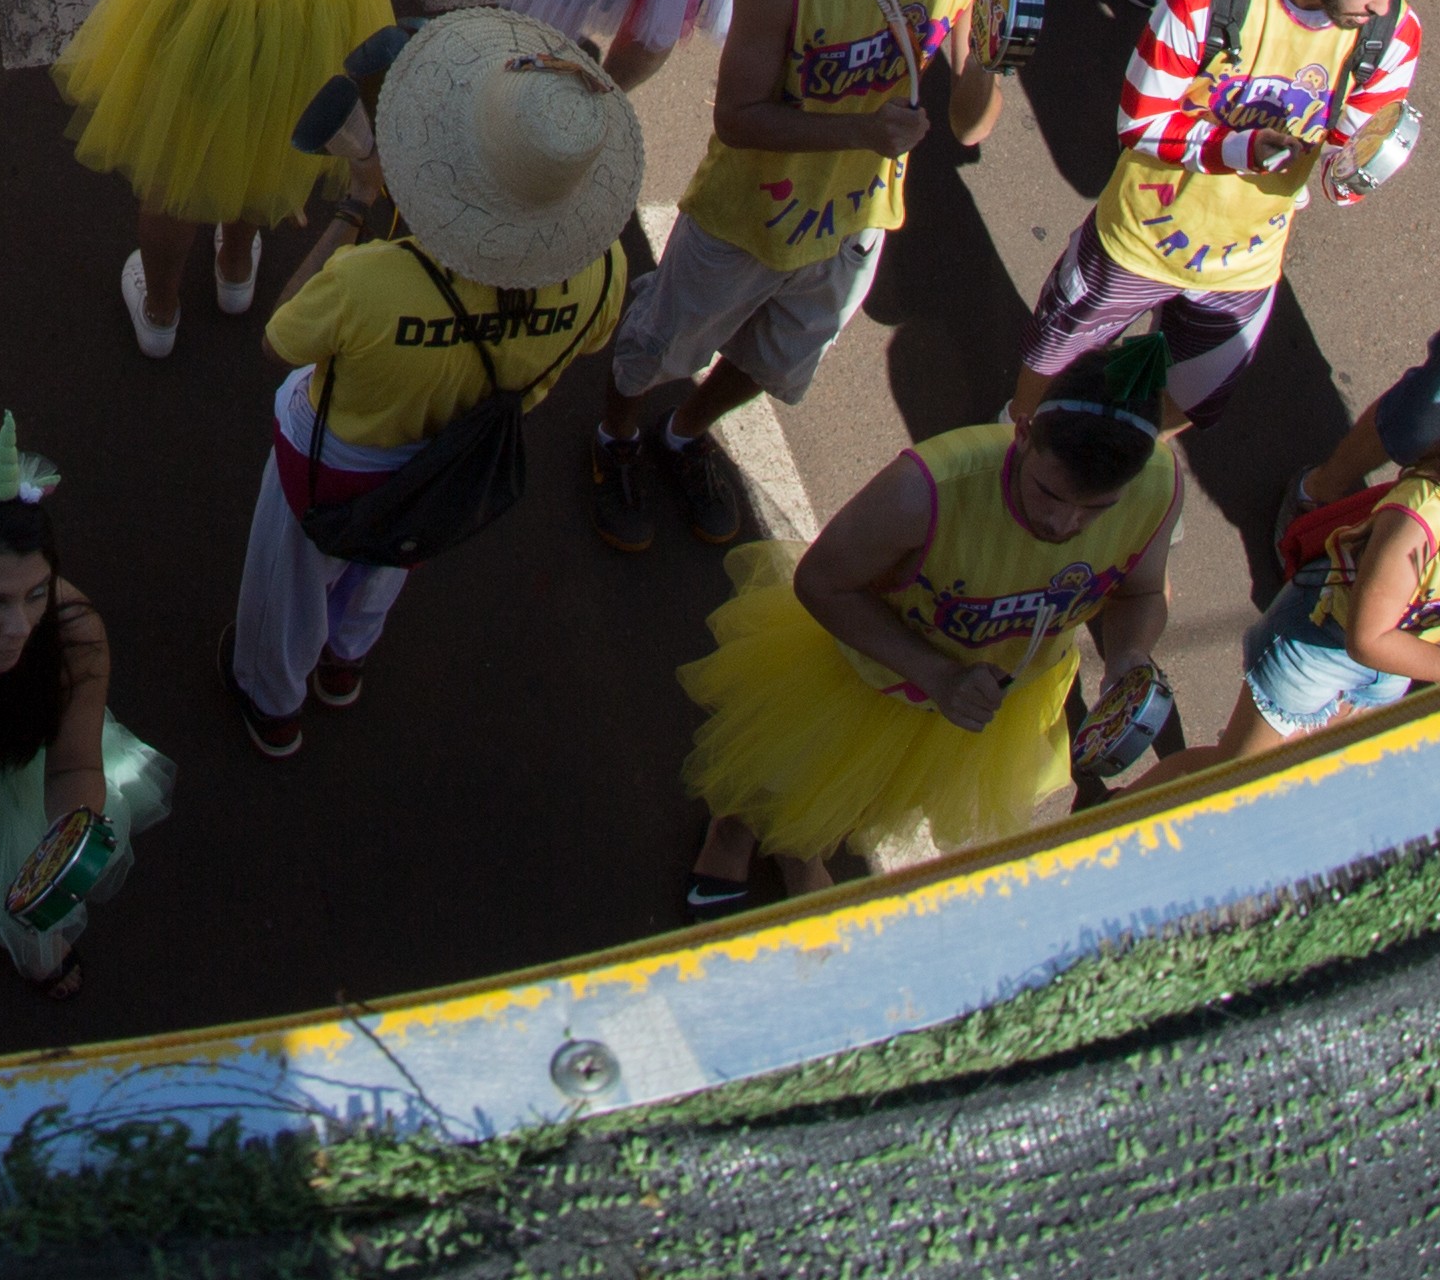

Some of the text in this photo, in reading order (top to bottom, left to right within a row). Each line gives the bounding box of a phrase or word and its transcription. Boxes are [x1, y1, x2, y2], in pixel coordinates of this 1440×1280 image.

[849, 35, 891, 69] OI
[1137, 182, 1288, 274] PIRATAS
[991, 595, 1047, 621] OI
